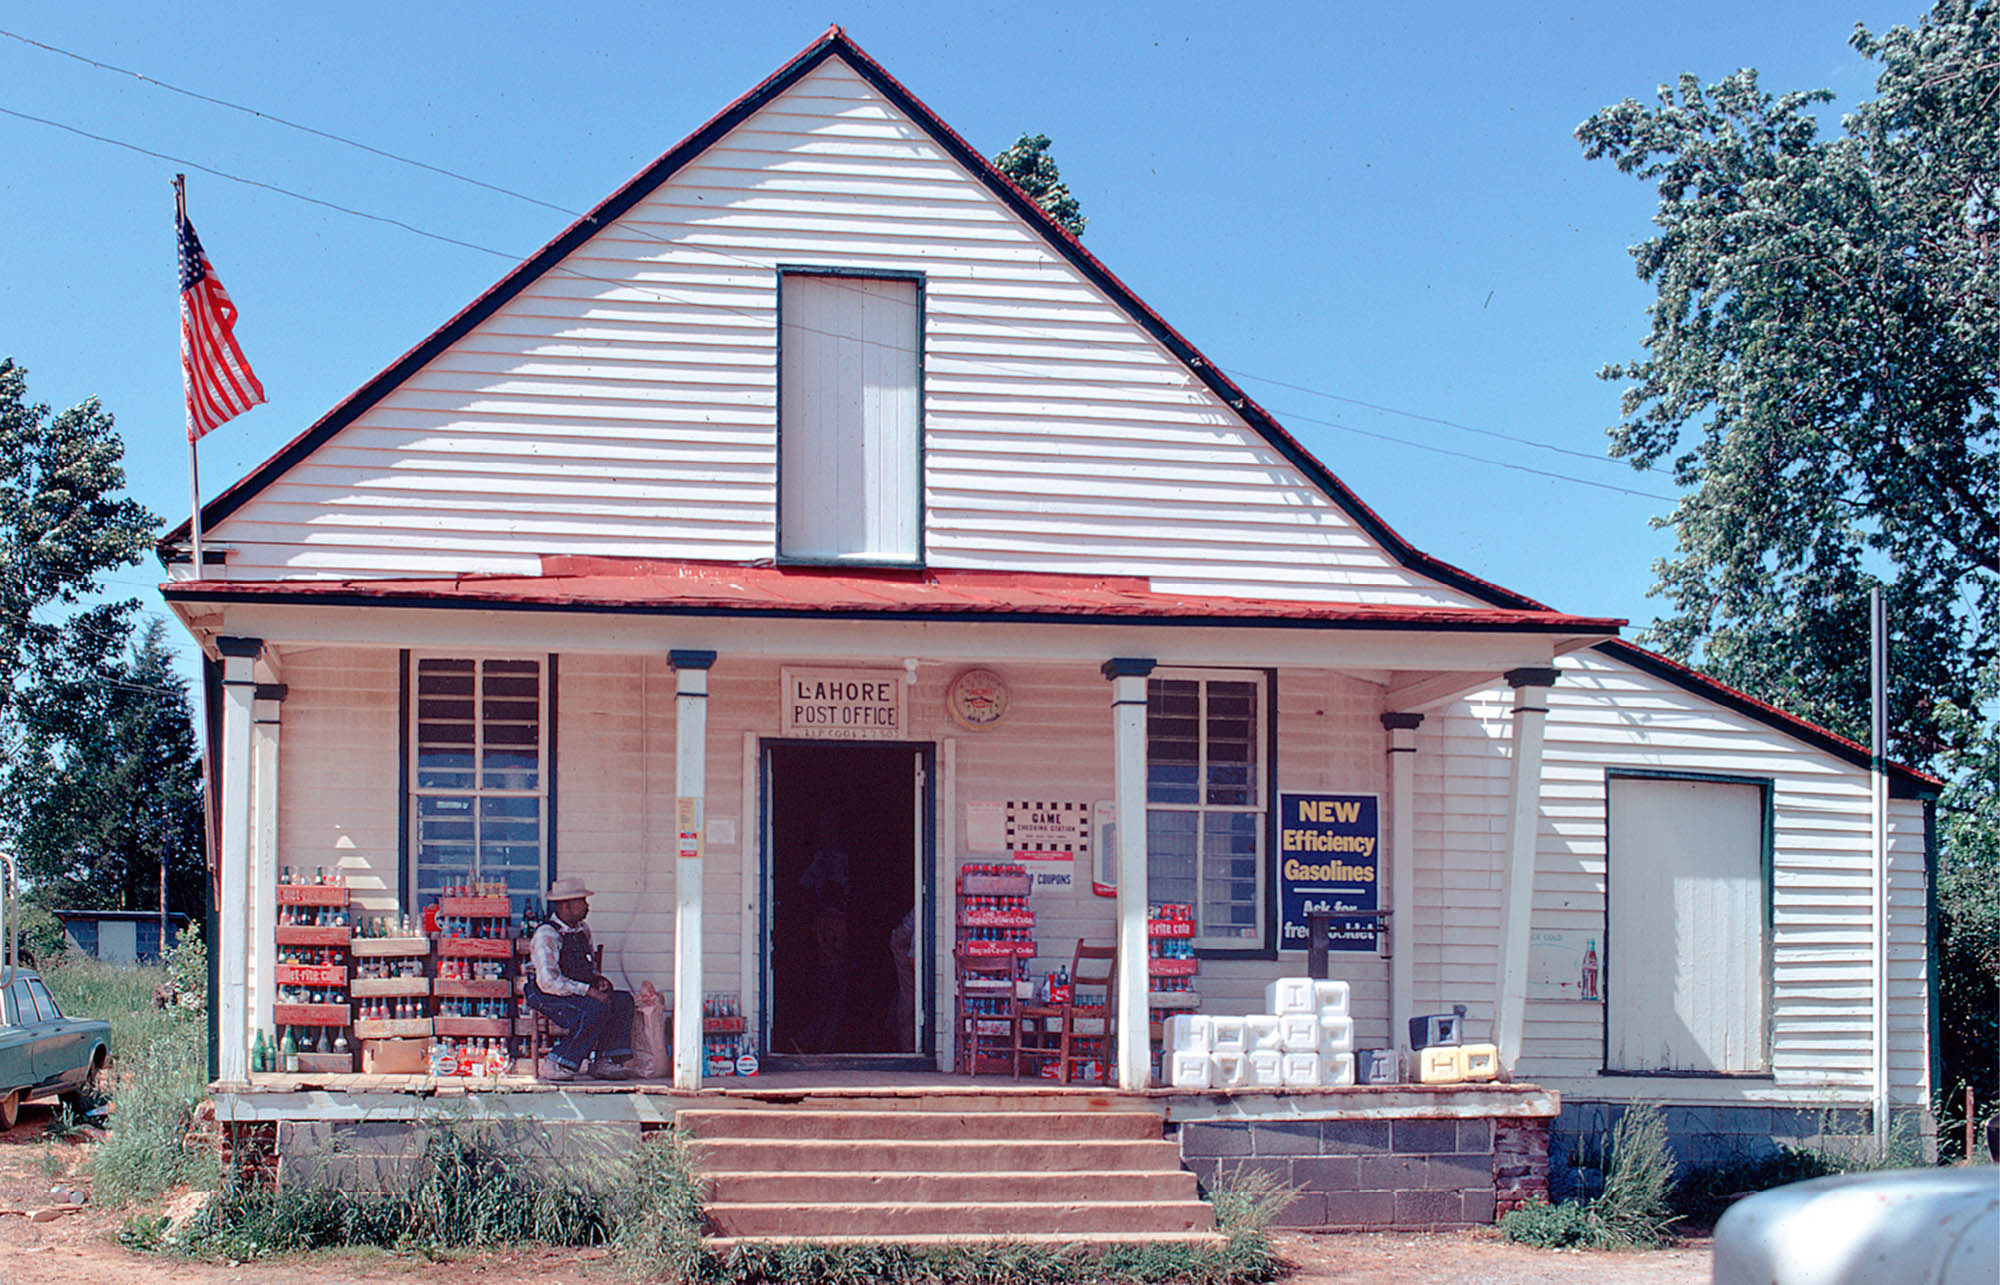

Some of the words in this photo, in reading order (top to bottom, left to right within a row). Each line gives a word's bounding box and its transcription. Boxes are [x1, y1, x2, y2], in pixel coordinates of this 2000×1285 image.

[798, 682, 890, 701] LAHORE
[795, 706, 837, 724] POST
[843, 706, 895, 726] OFFICE
[1032, 813, 1061, 824] GAME
[1299, 801, 1360, 823] NEW
[1018, 824, 1048, 832] CHECKING
[1283, 829, 1376, 857] Efficiency
[1037, 874, 1072, 885] COUPONS
[1284, 859, 1375, 882] Gasolines
[1303, 900, 1330, 916] Ask
[1334, 901, 1358, 912] for
[1328, 922, 1375, 939] oklet
